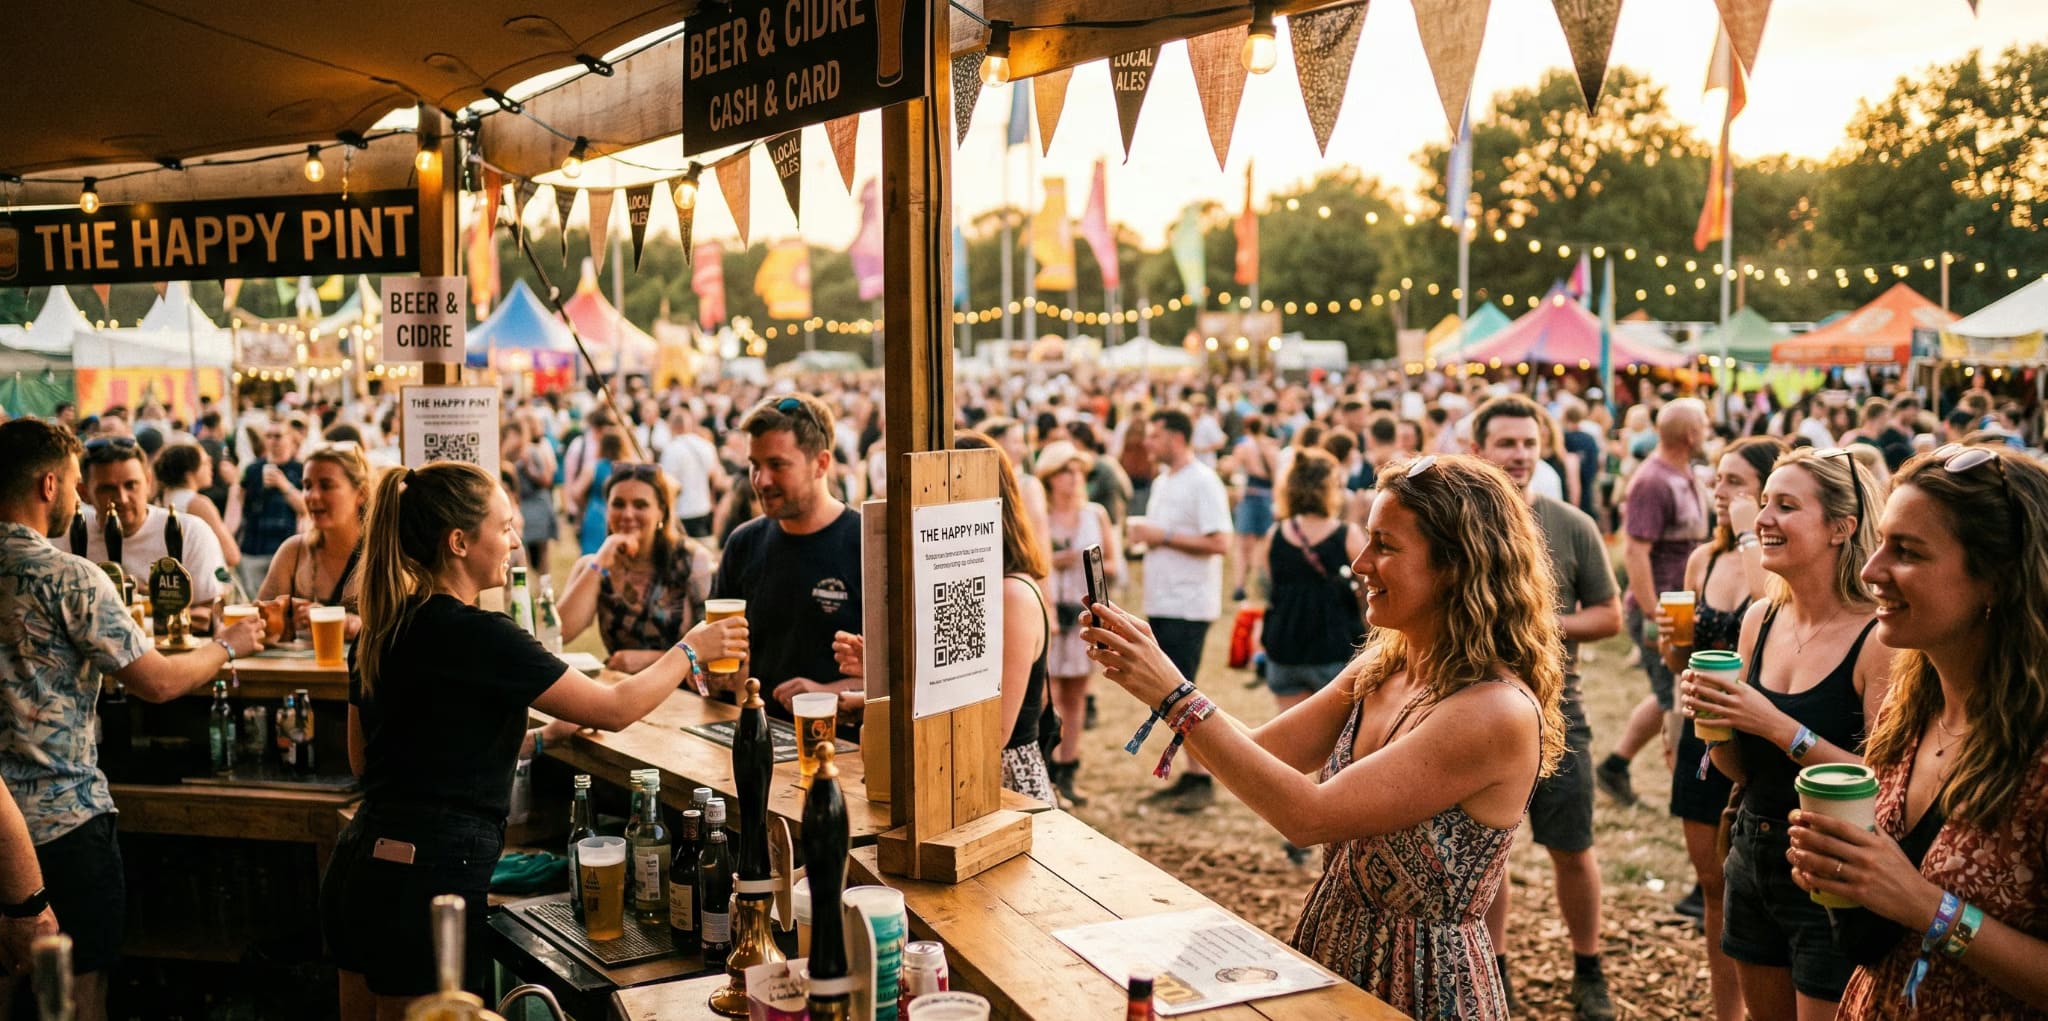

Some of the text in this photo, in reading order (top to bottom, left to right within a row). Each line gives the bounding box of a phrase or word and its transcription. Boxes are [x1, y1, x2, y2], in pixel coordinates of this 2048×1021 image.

[690, 17, 748, 81] BEER
[757, 7, 776, 57] &
[1114, 48, 1153, 67] LOCAL
[1115, 71, 1146, 91] ALES
[709, 59, 841, 132] CASH & CARD
[773, 137, 800, 164] LOCAL
[780, 156, 800, 180] ALES
[629, 194, 650, 210] LOCAL
[34, 205, 414, 271] THE HAPPY PINT
[390, 292, 458, 314] BEER &
[397, 324, 453, 348] CIDRE
[411, 398, 491, 408] THE HAPPY PINT
[920, 521, 995, 543] THE HAPPY PINT
[159, 575, 180, 588] ALE
